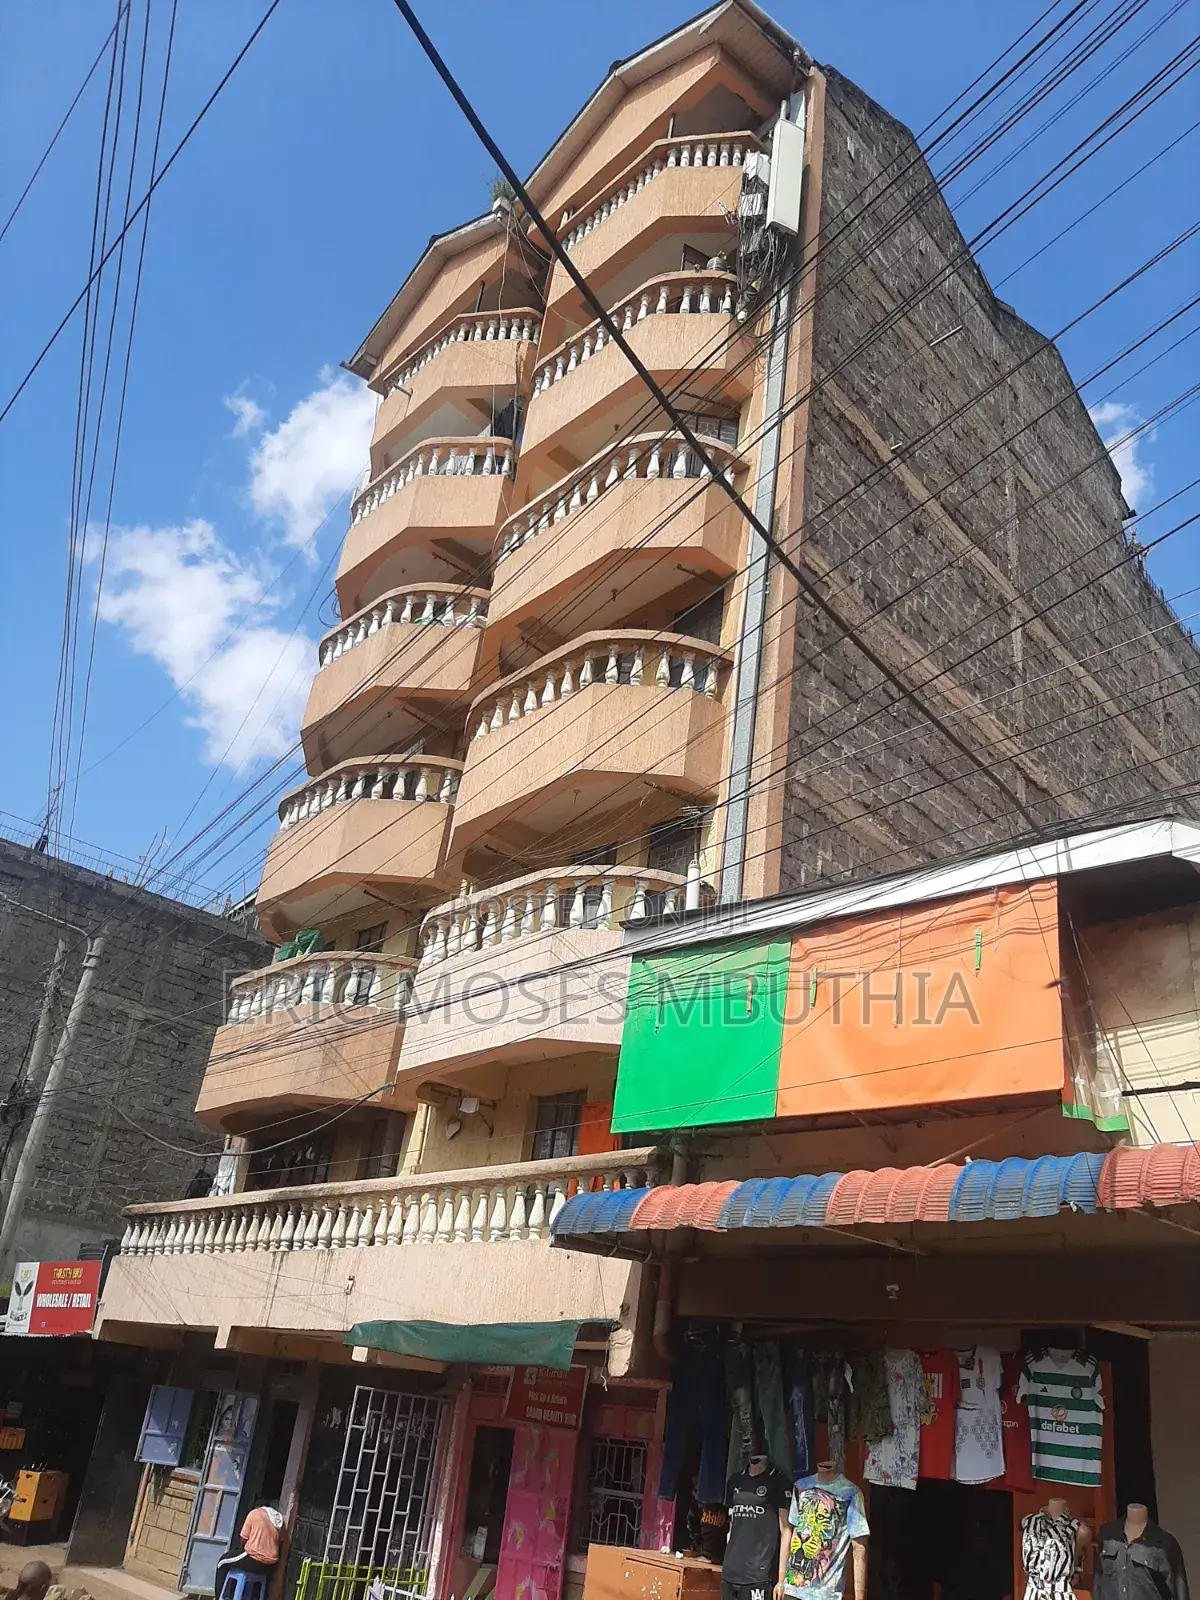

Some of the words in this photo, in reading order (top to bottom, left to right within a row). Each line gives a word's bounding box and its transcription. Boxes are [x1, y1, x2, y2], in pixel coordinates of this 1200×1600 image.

[36, 1293, 68, 1308] WHOLESALE
[72, 1293, 92, 1308] RETAIL
[1041, 1422, 1080, 1434] dafabet
